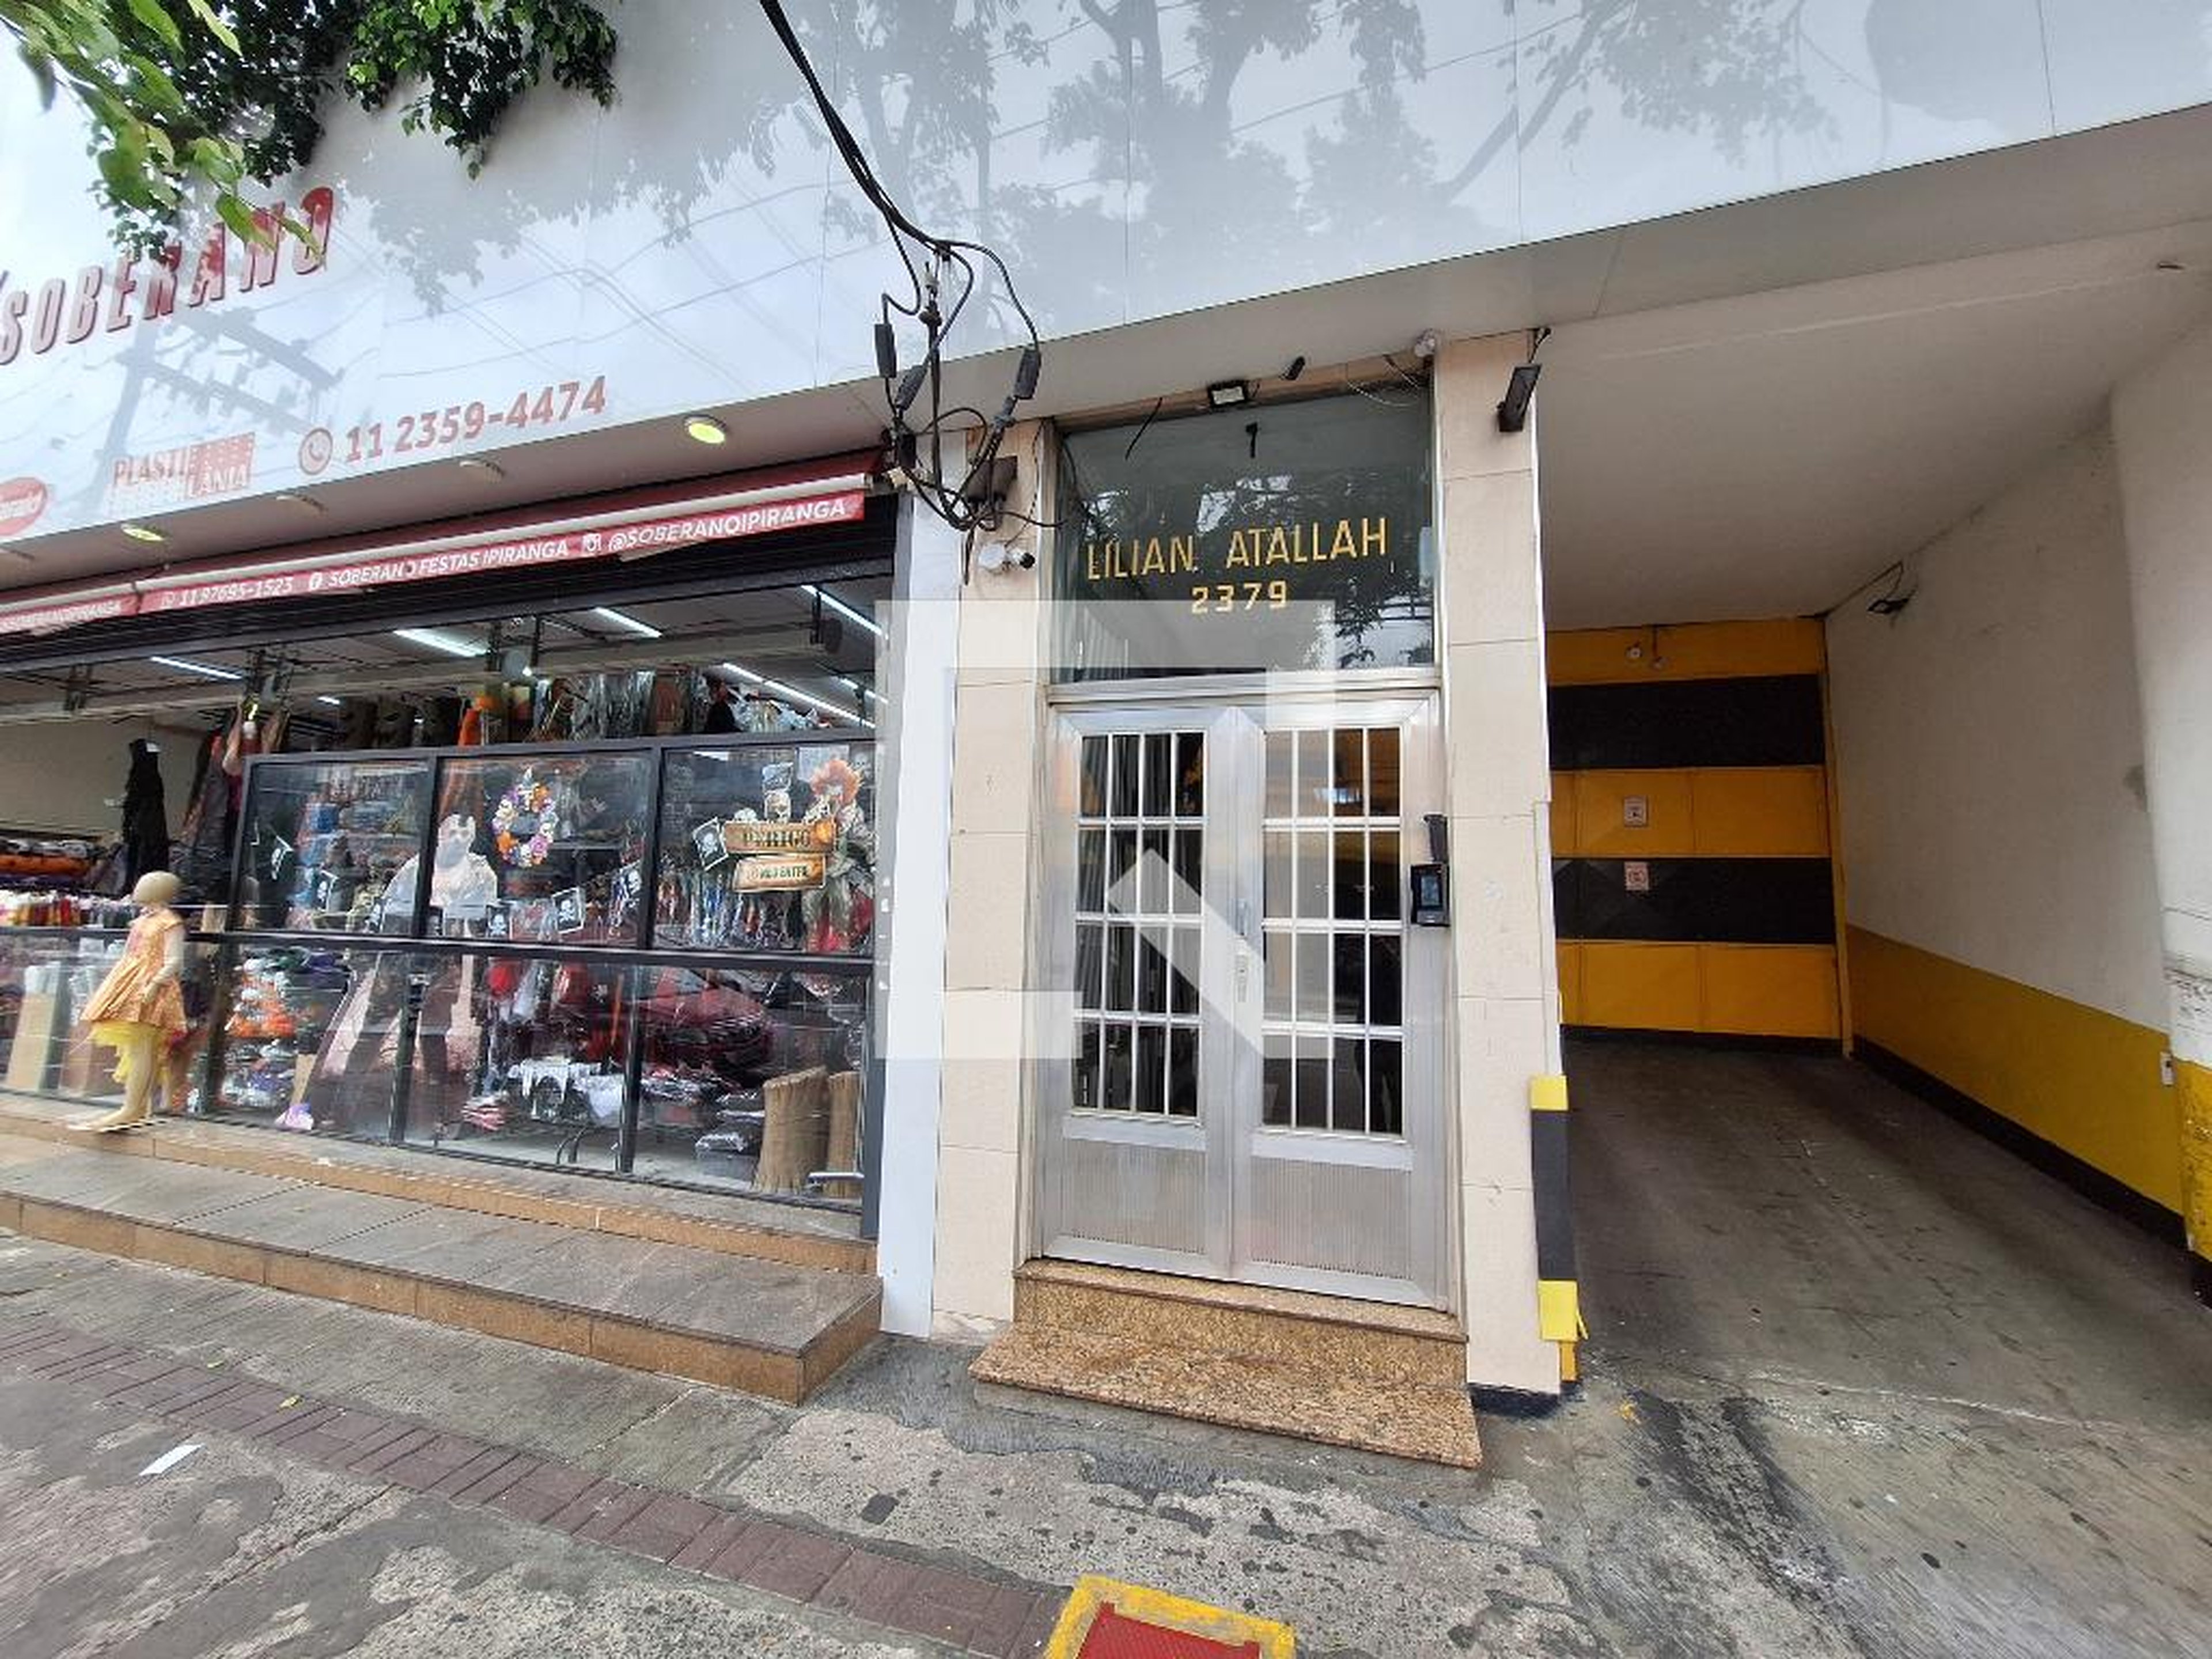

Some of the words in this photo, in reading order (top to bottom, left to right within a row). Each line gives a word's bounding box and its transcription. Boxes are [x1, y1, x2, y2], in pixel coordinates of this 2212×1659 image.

[347, 423, 383, 461] 11
[395, 375, 605, 453] 2359-4474
[419, 551, 479, 574] FESTAS
[483, 539, 569, 567] IPIRANGA
[1226, 517, 1386, 569] ATALLAH
[1190, 579, 1288, 614] 2379
